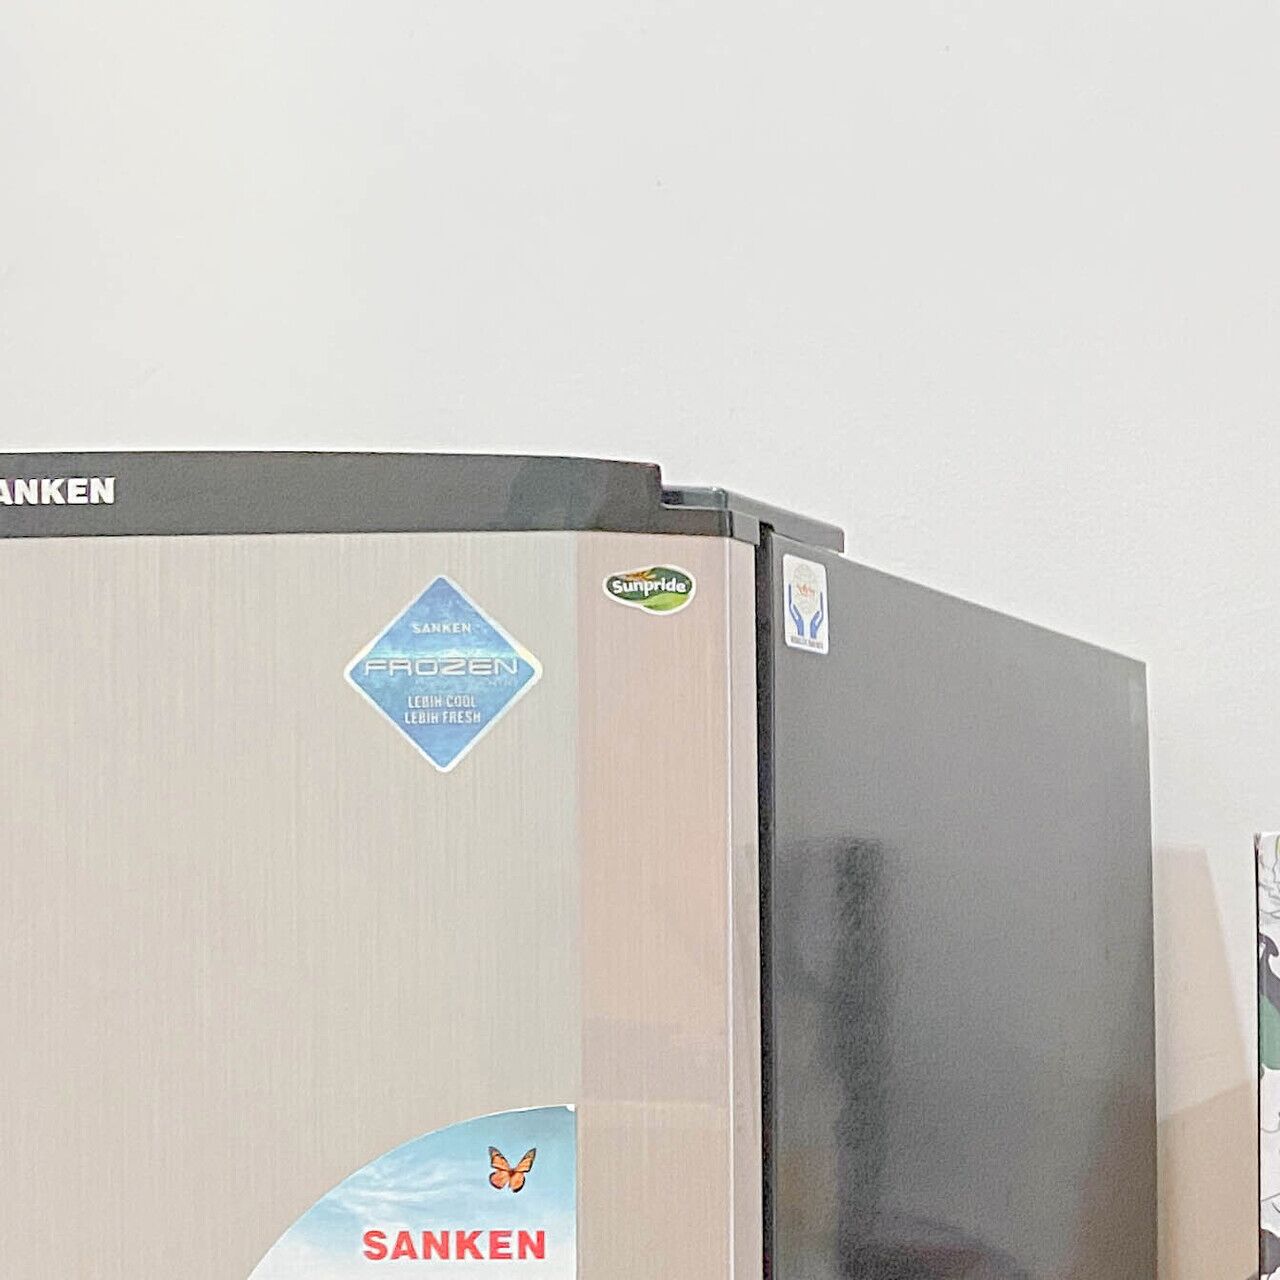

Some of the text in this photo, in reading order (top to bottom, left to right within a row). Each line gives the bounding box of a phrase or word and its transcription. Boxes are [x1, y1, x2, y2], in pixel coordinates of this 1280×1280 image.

[612, 577, 687, 597] Sunpride
[412, 623, 472, 634] SANKEN
[364, 657, 518, 677] FROZEN
[446, 695, 477, 708] COOL
[443, 711, 481, 724] FRESH
[363, 1230, 545, 1260] SANKEN
